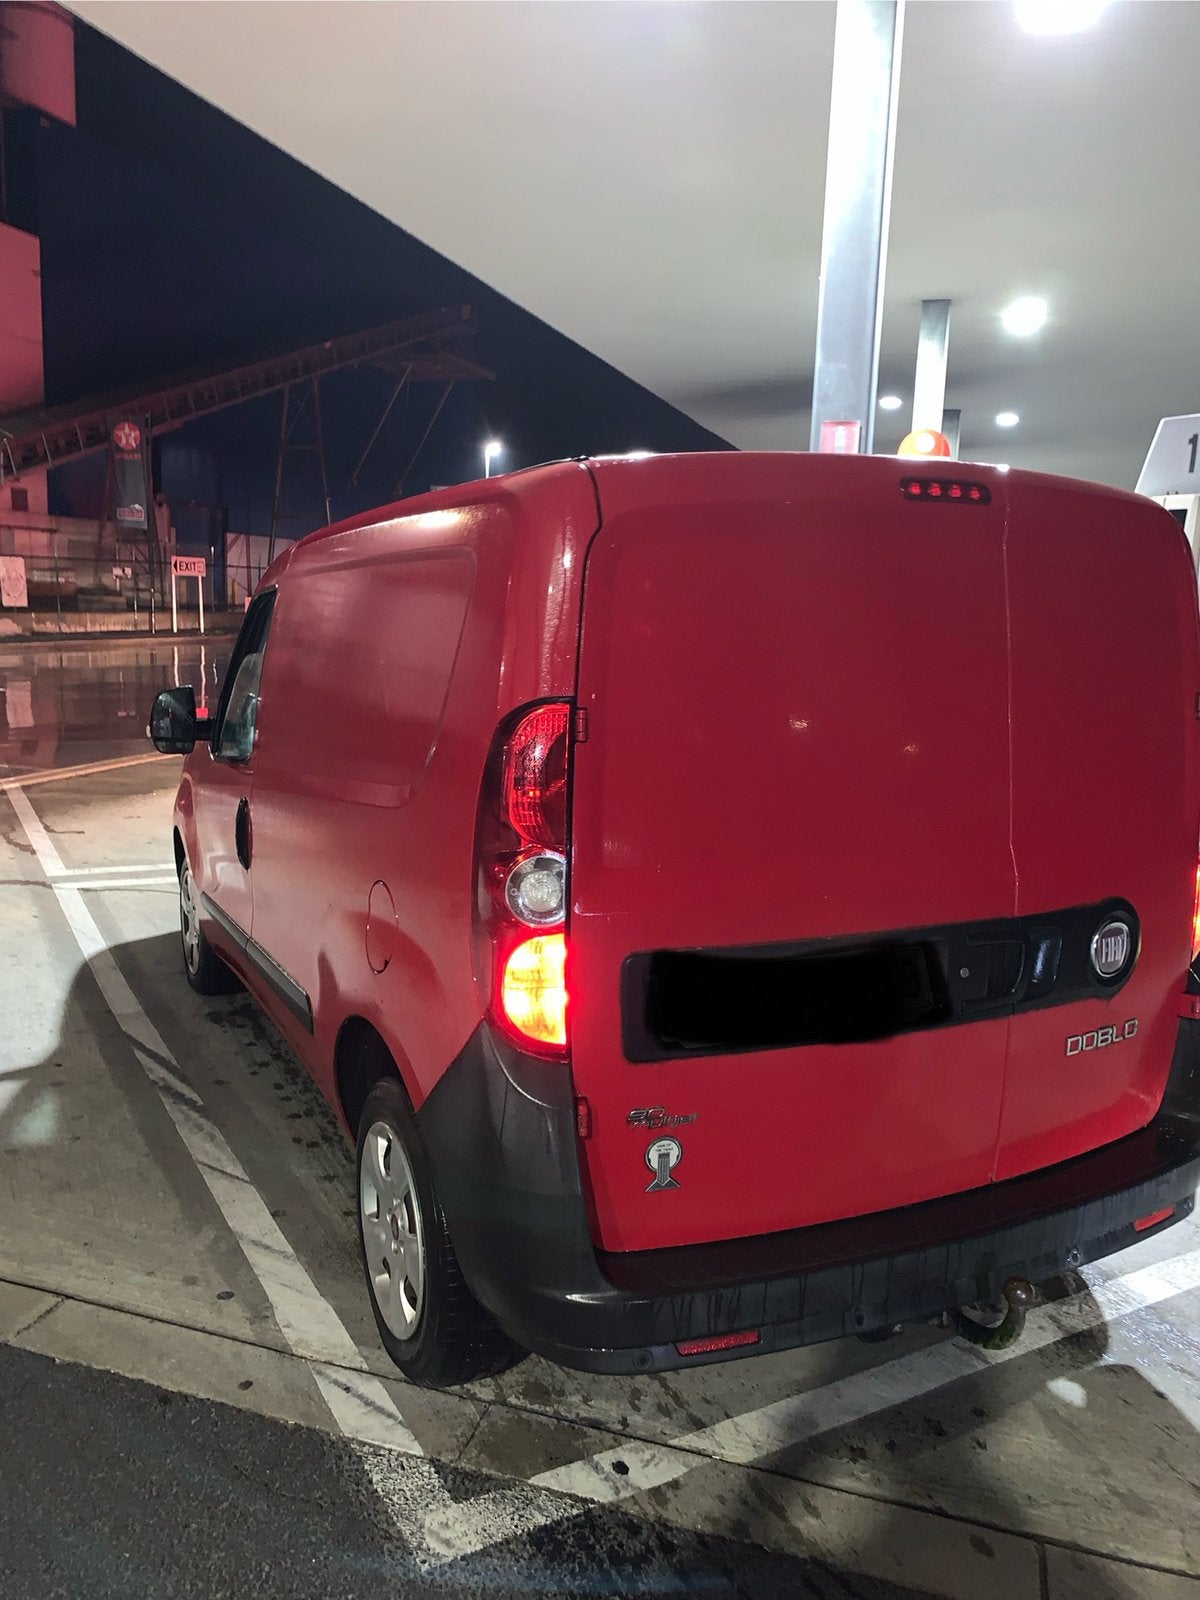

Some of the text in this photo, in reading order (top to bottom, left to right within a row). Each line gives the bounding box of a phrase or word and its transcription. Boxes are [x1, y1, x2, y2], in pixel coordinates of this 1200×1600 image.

[1188, 433, 1198, 473] 1
[178, 560, 196, 572] EXIT
[1101, 936, 1122, 963] FIAT
[1066, 1018, 1139, 1056] DOBLO
